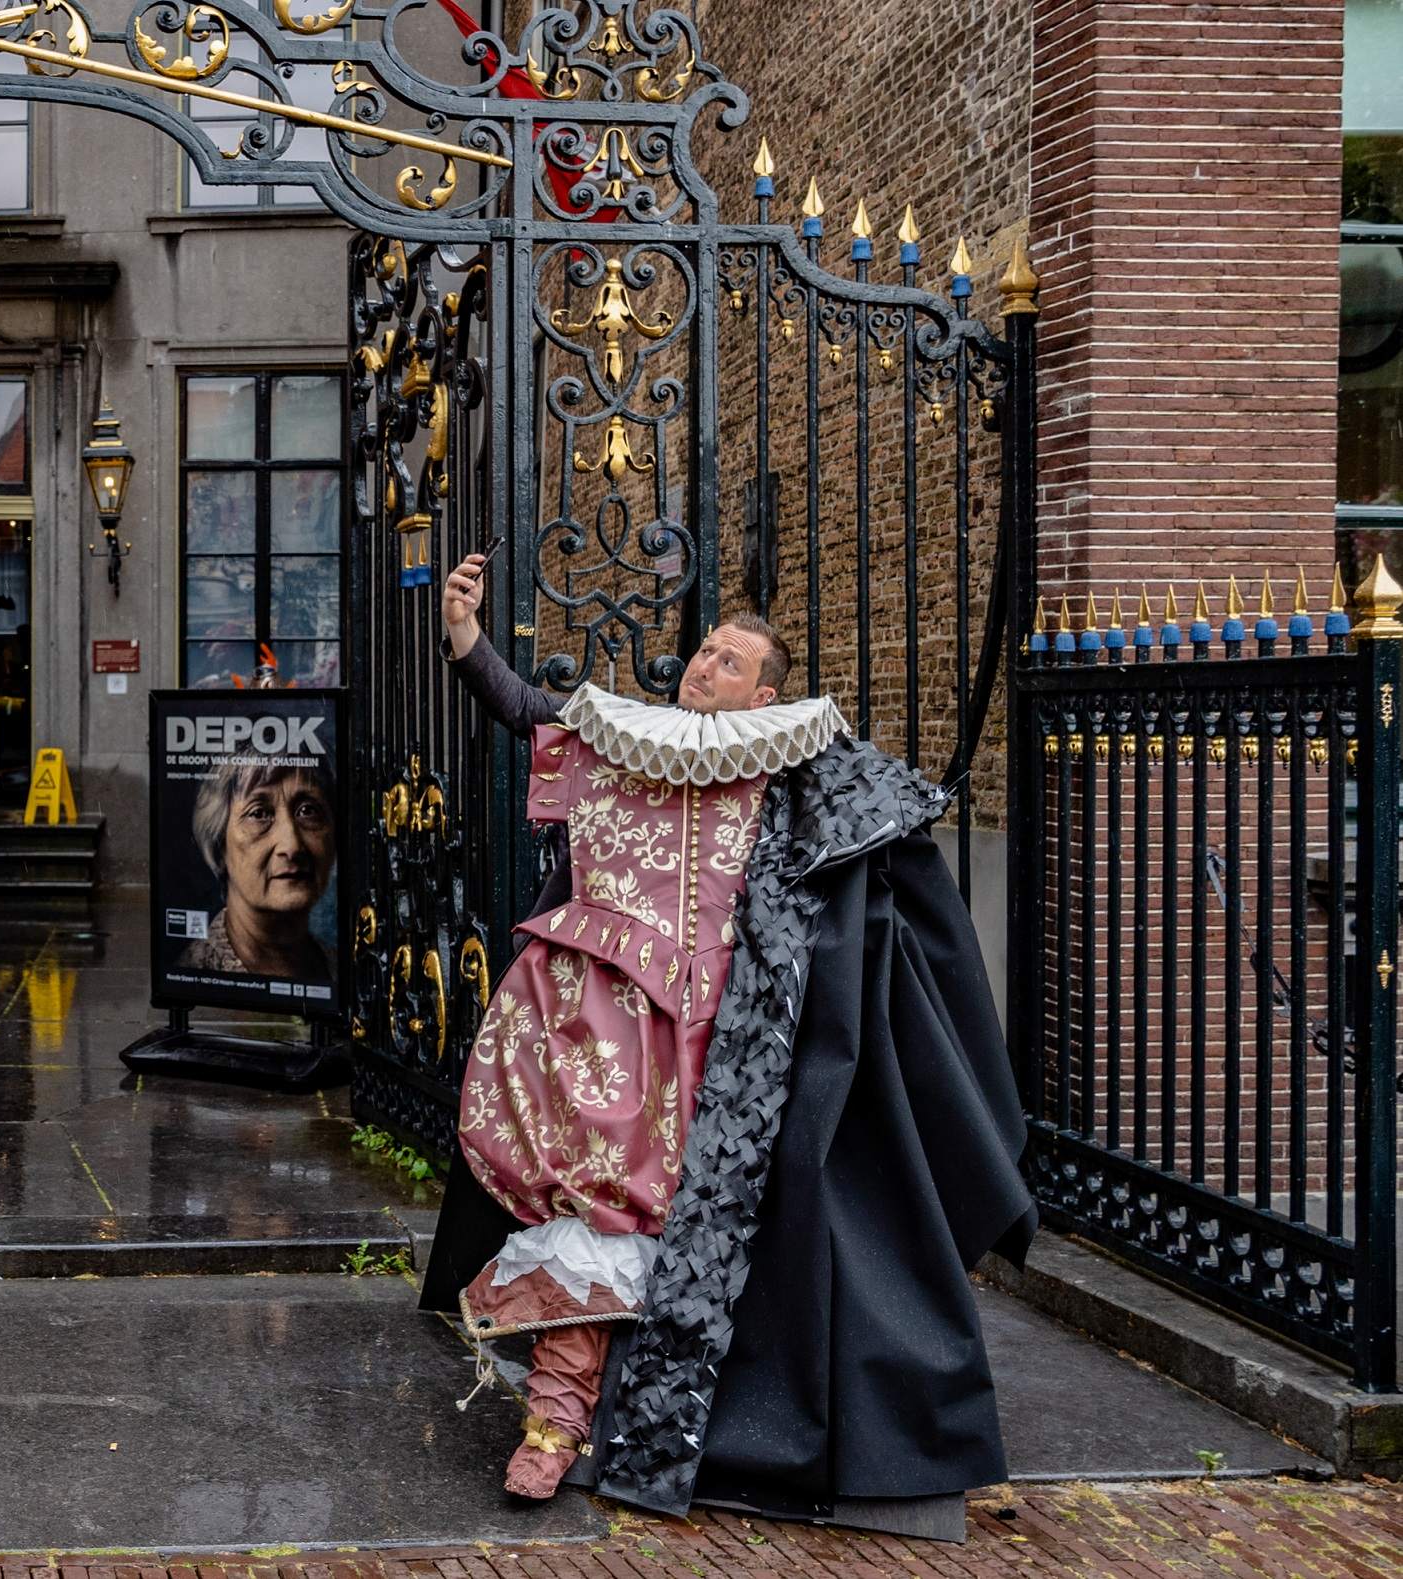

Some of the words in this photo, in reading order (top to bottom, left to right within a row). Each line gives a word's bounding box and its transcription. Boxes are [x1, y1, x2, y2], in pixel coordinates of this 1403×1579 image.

[166, 716, 326, 755] DEPOK
[166, 755, 177, 765] DE
[178, 755, 209, 765] DROOM
[211, 756, 228, 766] VAN
